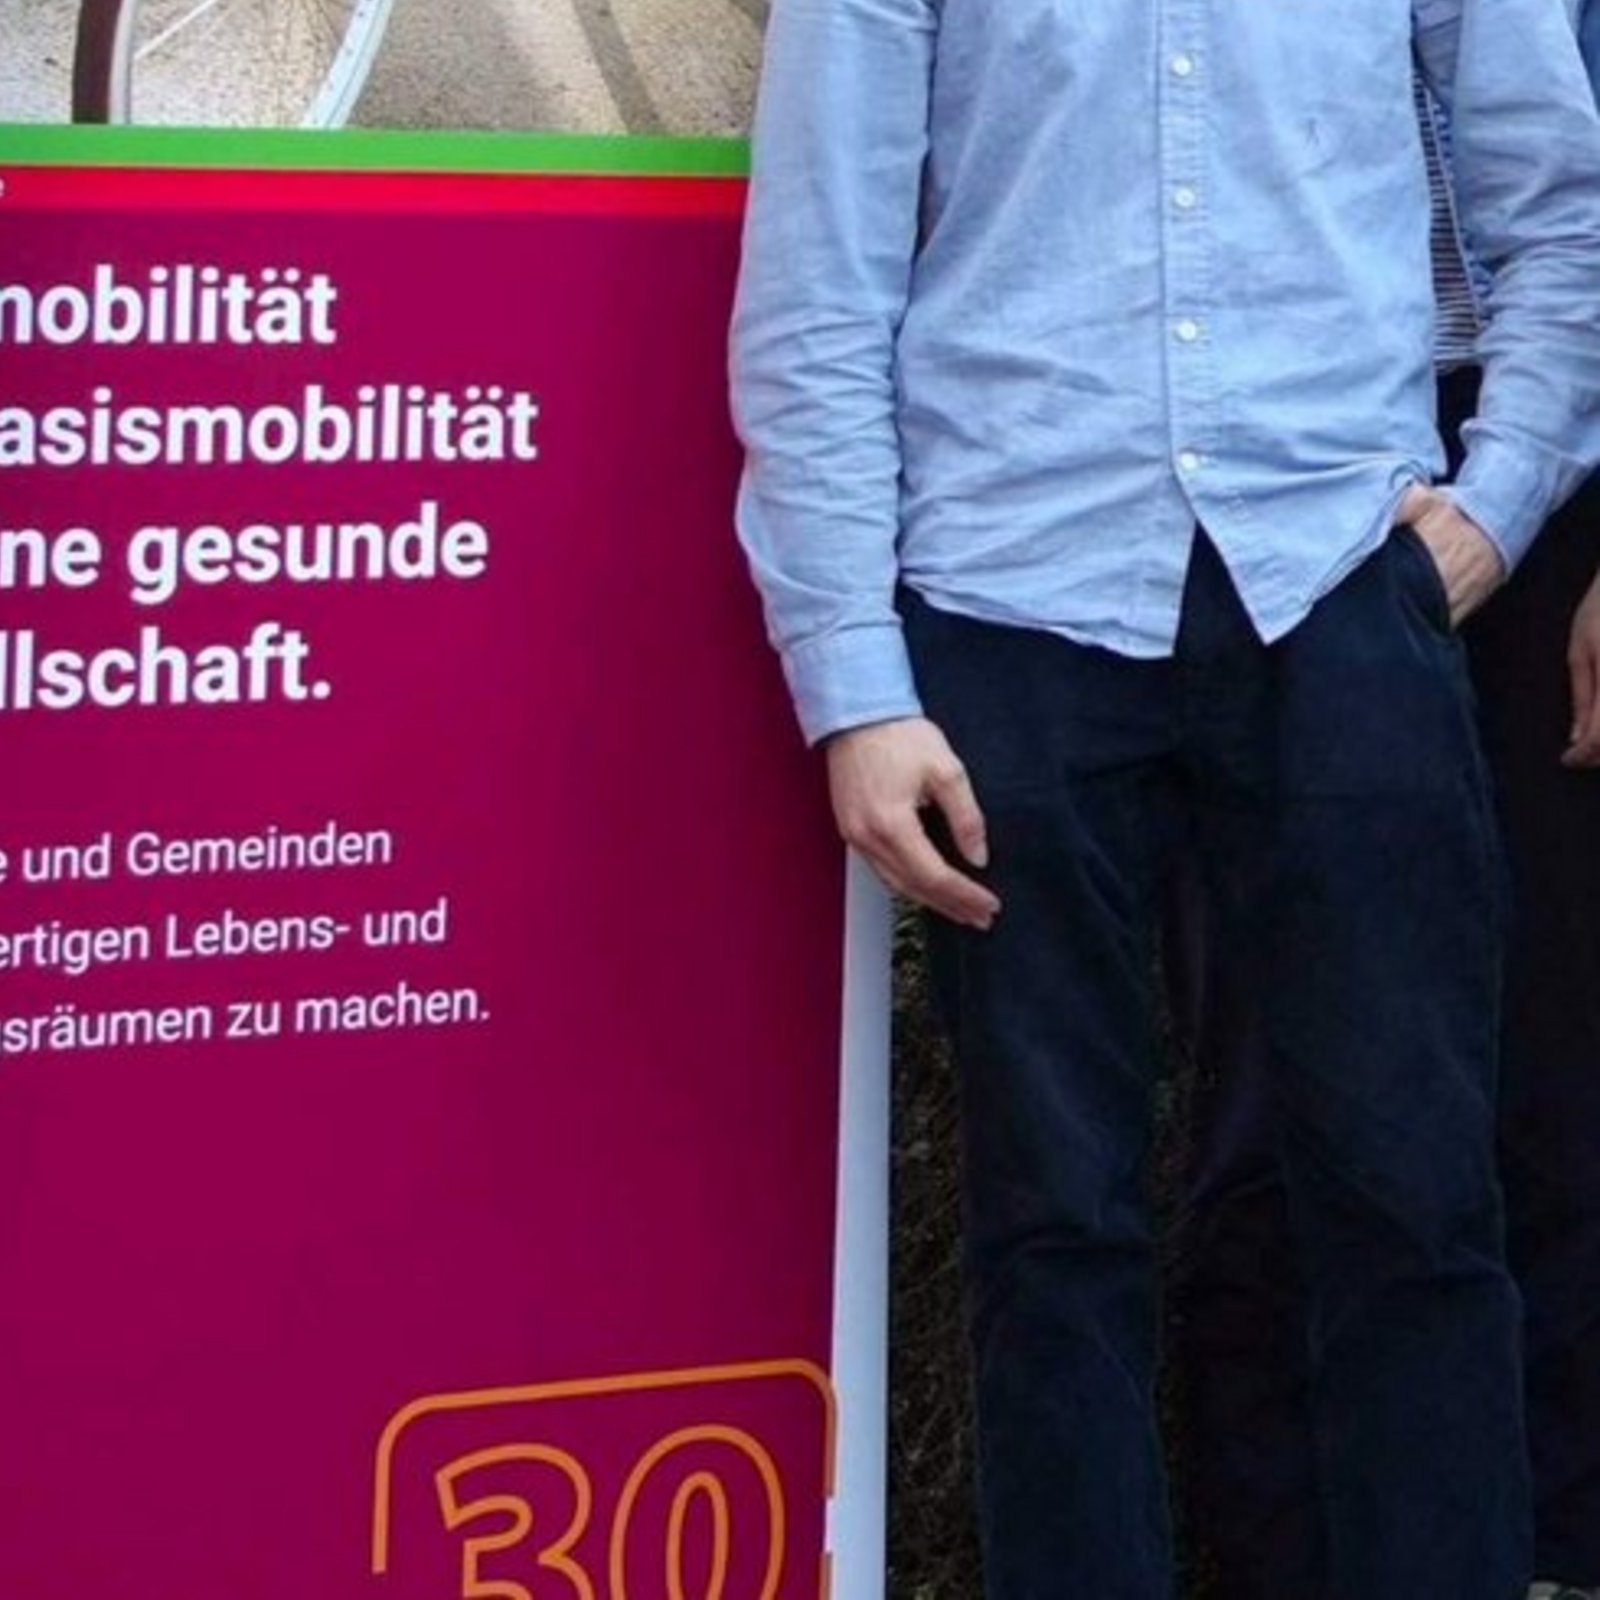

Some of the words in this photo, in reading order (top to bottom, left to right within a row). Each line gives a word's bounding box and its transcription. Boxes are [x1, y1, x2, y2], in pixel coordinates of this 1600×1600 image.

[127, 500, 489, 605] gesunde
[22, 833, 111, 882] und
[127, 821, 392, 877] Gemeinden
[166, 910, 351, 958] Lebens-
[364, 898, 447, 947] und
[226, 1002, 281, 1038] zu
[296, 982, 491, 1033] machen.
[434, 1423, 785, 1600] 30
